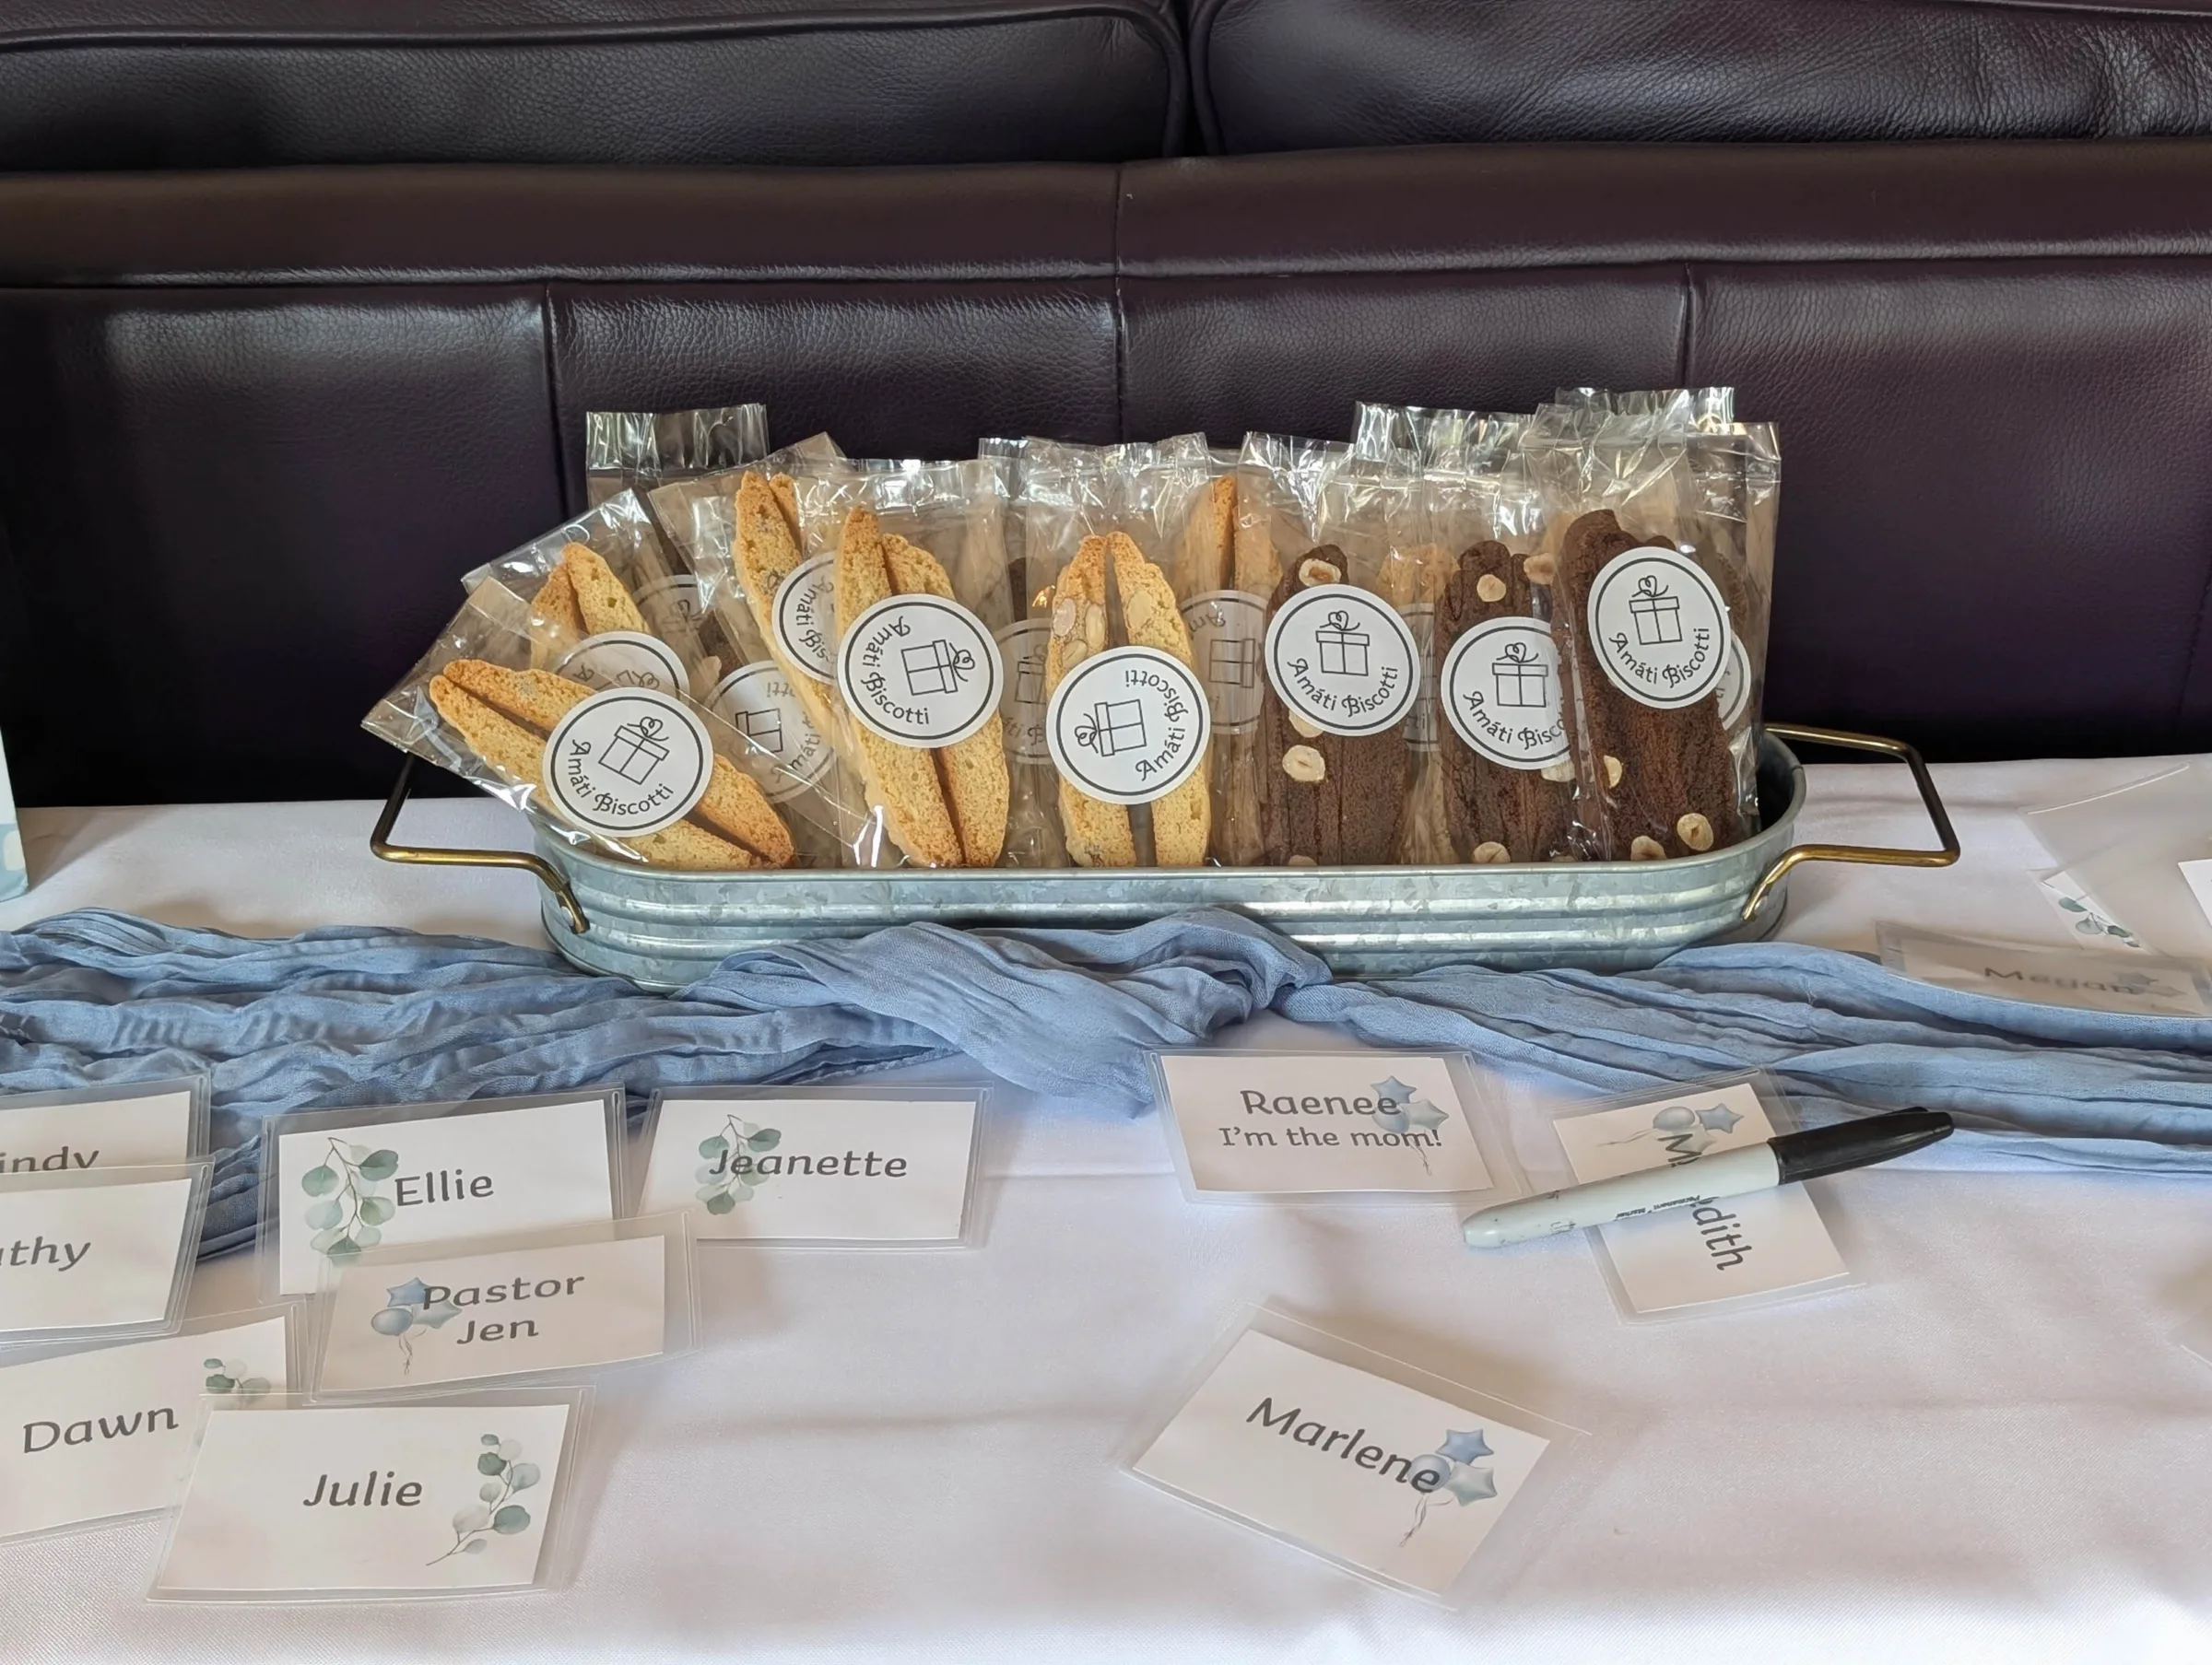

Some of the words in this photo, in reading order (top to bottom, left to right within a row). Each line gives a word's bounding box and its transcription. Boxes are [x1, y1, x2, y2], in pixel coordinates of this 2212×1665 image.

[1662, 627, 1710, 688] Biscotti
[860, 672, 929, 724] Biscotti
[1125, 670, 1189, 722] Biscotti
[1341, 666, 1398, 718] Biscotti
[593, 783, 674, 815] Biscotti
[1240, 1090, 1402, 1116] Raenee
[1286, 1126, 1340, 1146] the
[1350, 1129, 1442, 1147] mom!
[709, 1149, 908, 1178] Jeanette
[394, 1168, 495, 1207] Ellie
[422, 1276, 585, 1310] Pastor
[456, 1319, 539, 1344] Jen
[22, 1407, 179, 1454] Dawn
[1246, 1397, 1441, 1494] Marlene
[302, 1470, 423, 1507] Julie
